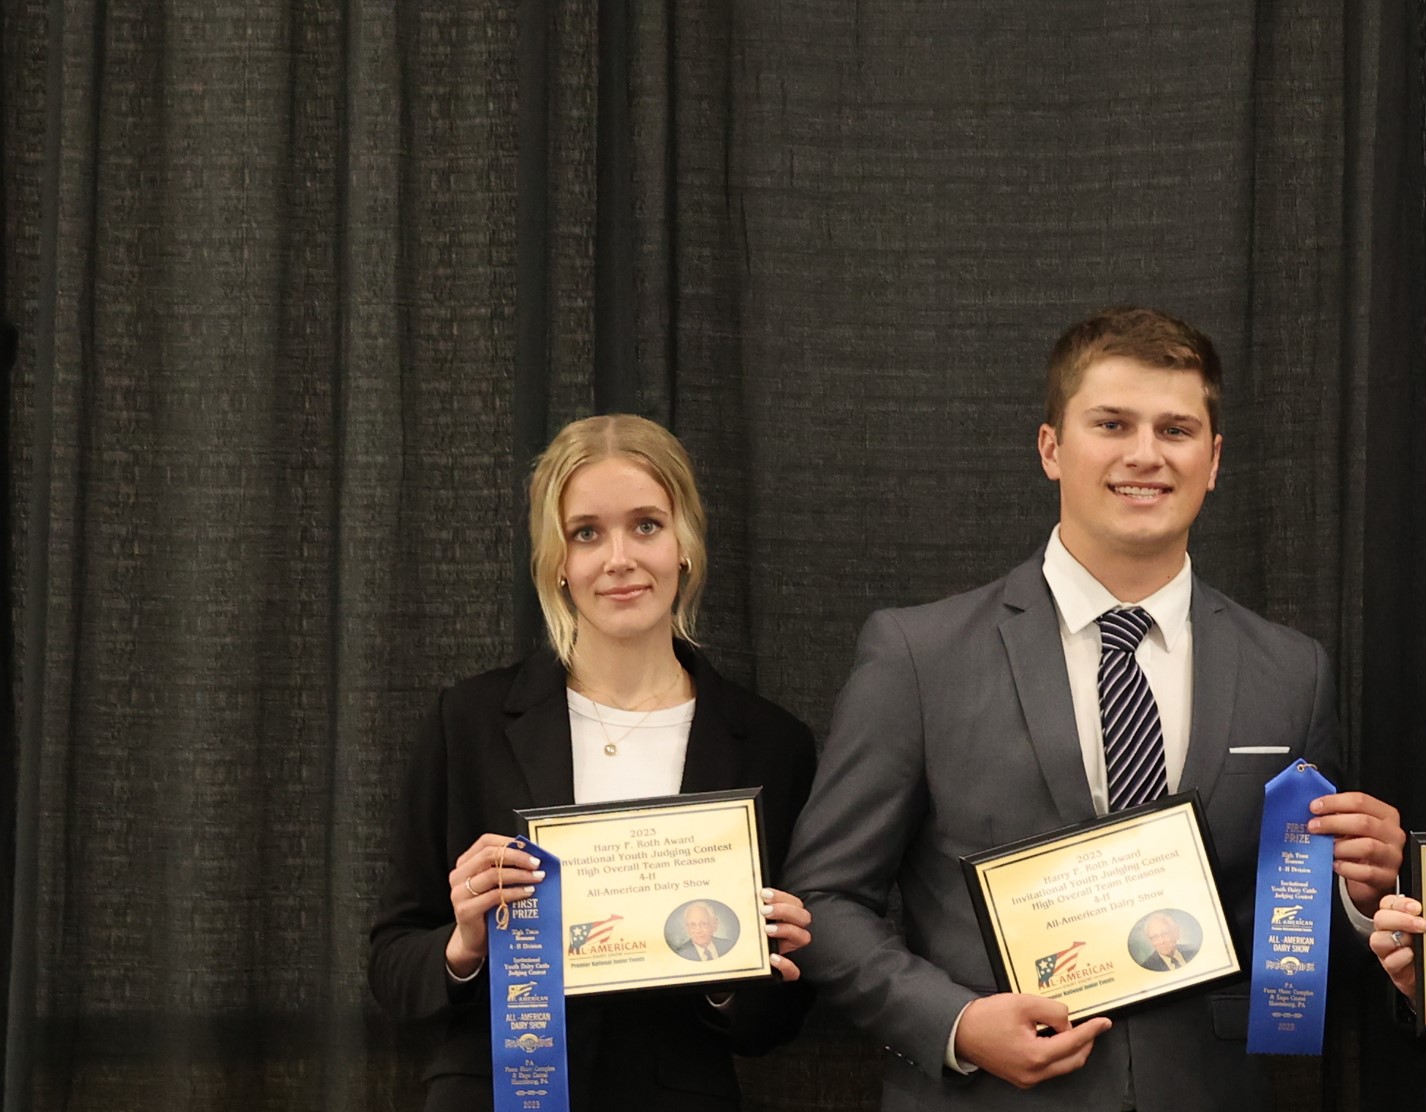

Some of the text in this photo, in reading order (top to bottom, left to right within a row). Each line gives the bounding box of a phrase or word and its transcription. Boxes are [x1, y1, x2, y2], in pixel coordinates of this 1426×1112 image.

[630, 829, 656, 838] 2023
[1286, 823, 1305, 833] FIRS
[594, 843, 620, 852] Harry
[637, 840, 660, 848] Roth
[664, 836, 694, 845] Award
[1284, 833, 1310, 844] PRIZE
[562, 843, 732, 866] nvitational Youth Judging Contest
[1077, 850, 1102, 863] 2023
[578, 857, 716, 877] High Overall Team Reasons
[1044, 870, 1070, 884] Harry
[1085, 860, 1108, 871] Roth
[1111, 850, 1141, 864] Award
[1012, 850, 1179, 905] Invitational Youth Judging Contest
[587, 878, 710, 897] All-American Dairy Show
[1032, 867, 1166, 911] High Overall Team Reasons
[512, 899, 538, 908] FIRST
[1094, 893, 1110, 902] 4-H
[512, 909, 539, 919] PRIZE
[1046, 889, 1164, 930] All-American Dairy Show
[1273, 944, 1309, 953] DAIRY SHOW
[511, 1022, 528, 1030] DAIRY
